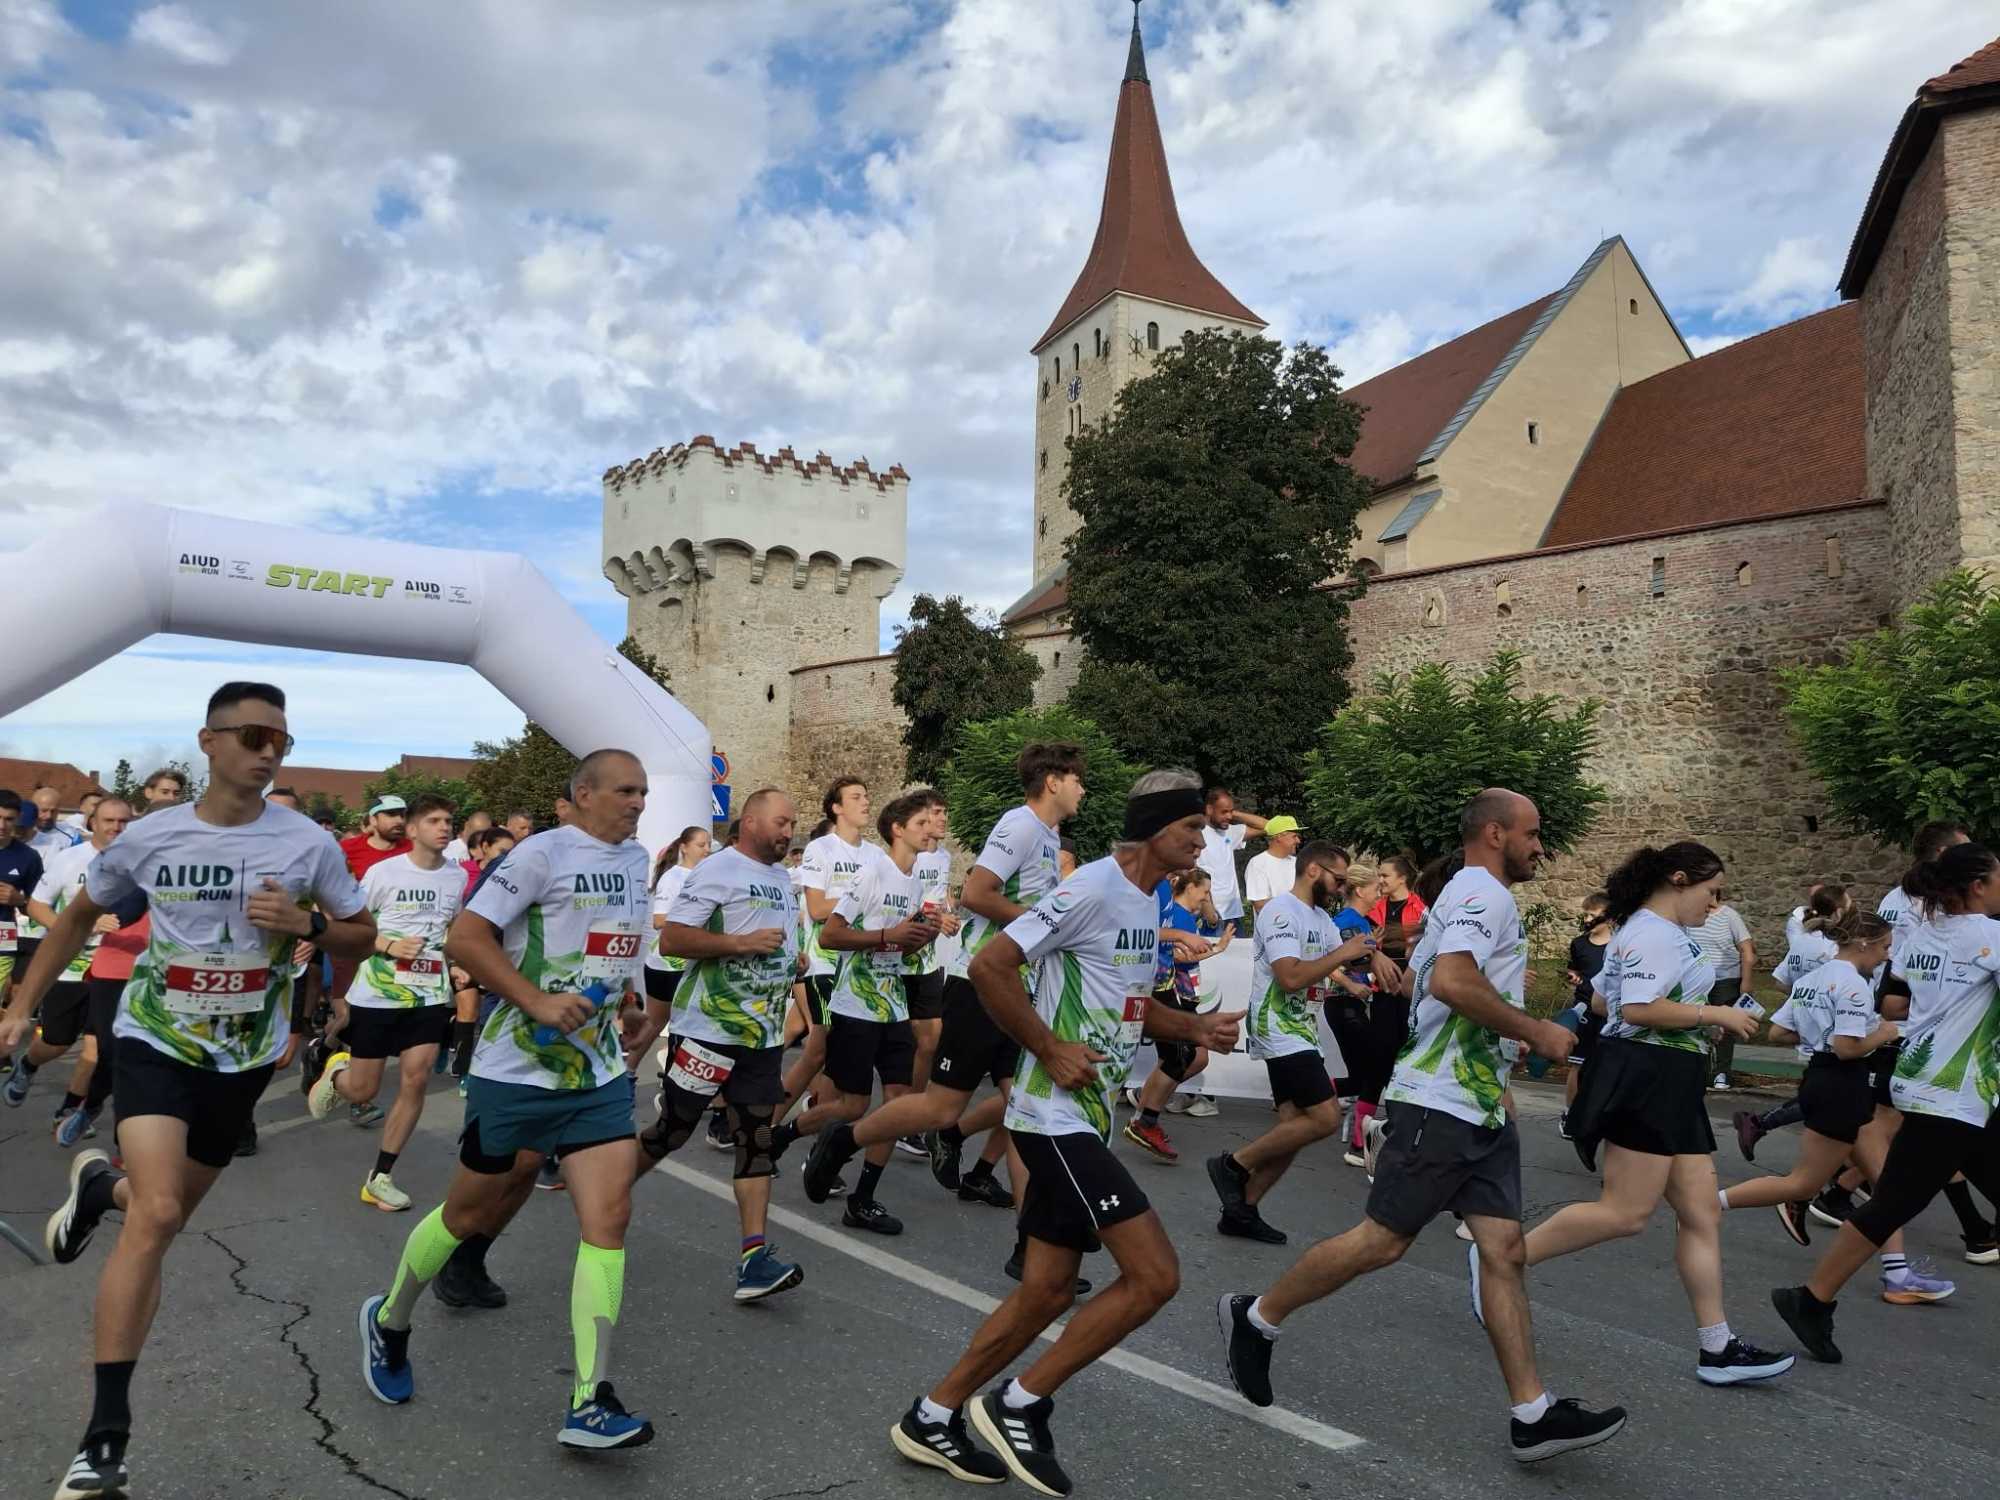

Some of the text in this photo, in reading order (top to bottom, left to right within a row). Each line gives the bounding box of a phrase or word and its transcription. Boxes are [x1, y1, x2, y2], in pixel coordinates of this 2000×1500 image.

[180, 553, 220, 568] AIUD
[265, 564, 394, 599] START
[405, 580, 440, 594] AIUD
[155, 865, 234, 888] AIUD
[574, 873, 625, 893] AIUD
[920, 870, 939, 880] AIUD
[154, 889, 233, 905] greenRUN
[396, 889, 436, 902] AIUD
[750, 884, 783, 900] AIUD
[574, 895, 625, 910] greenRUN
[883, 893, 909, 909] AIUD
[1456, 919, 1492, 938] WORLD
[606, 936, 637, 955] 657
[1114, 928, 1155, 950] AIUD
[410, 960, 433, 972] 631
[1906, 954, 1941, 970] AIUD
[190, 971, 246, 992] 528
[684, 1057, 716, 1080] 550
[940, 1058, 952, 1072] 21
